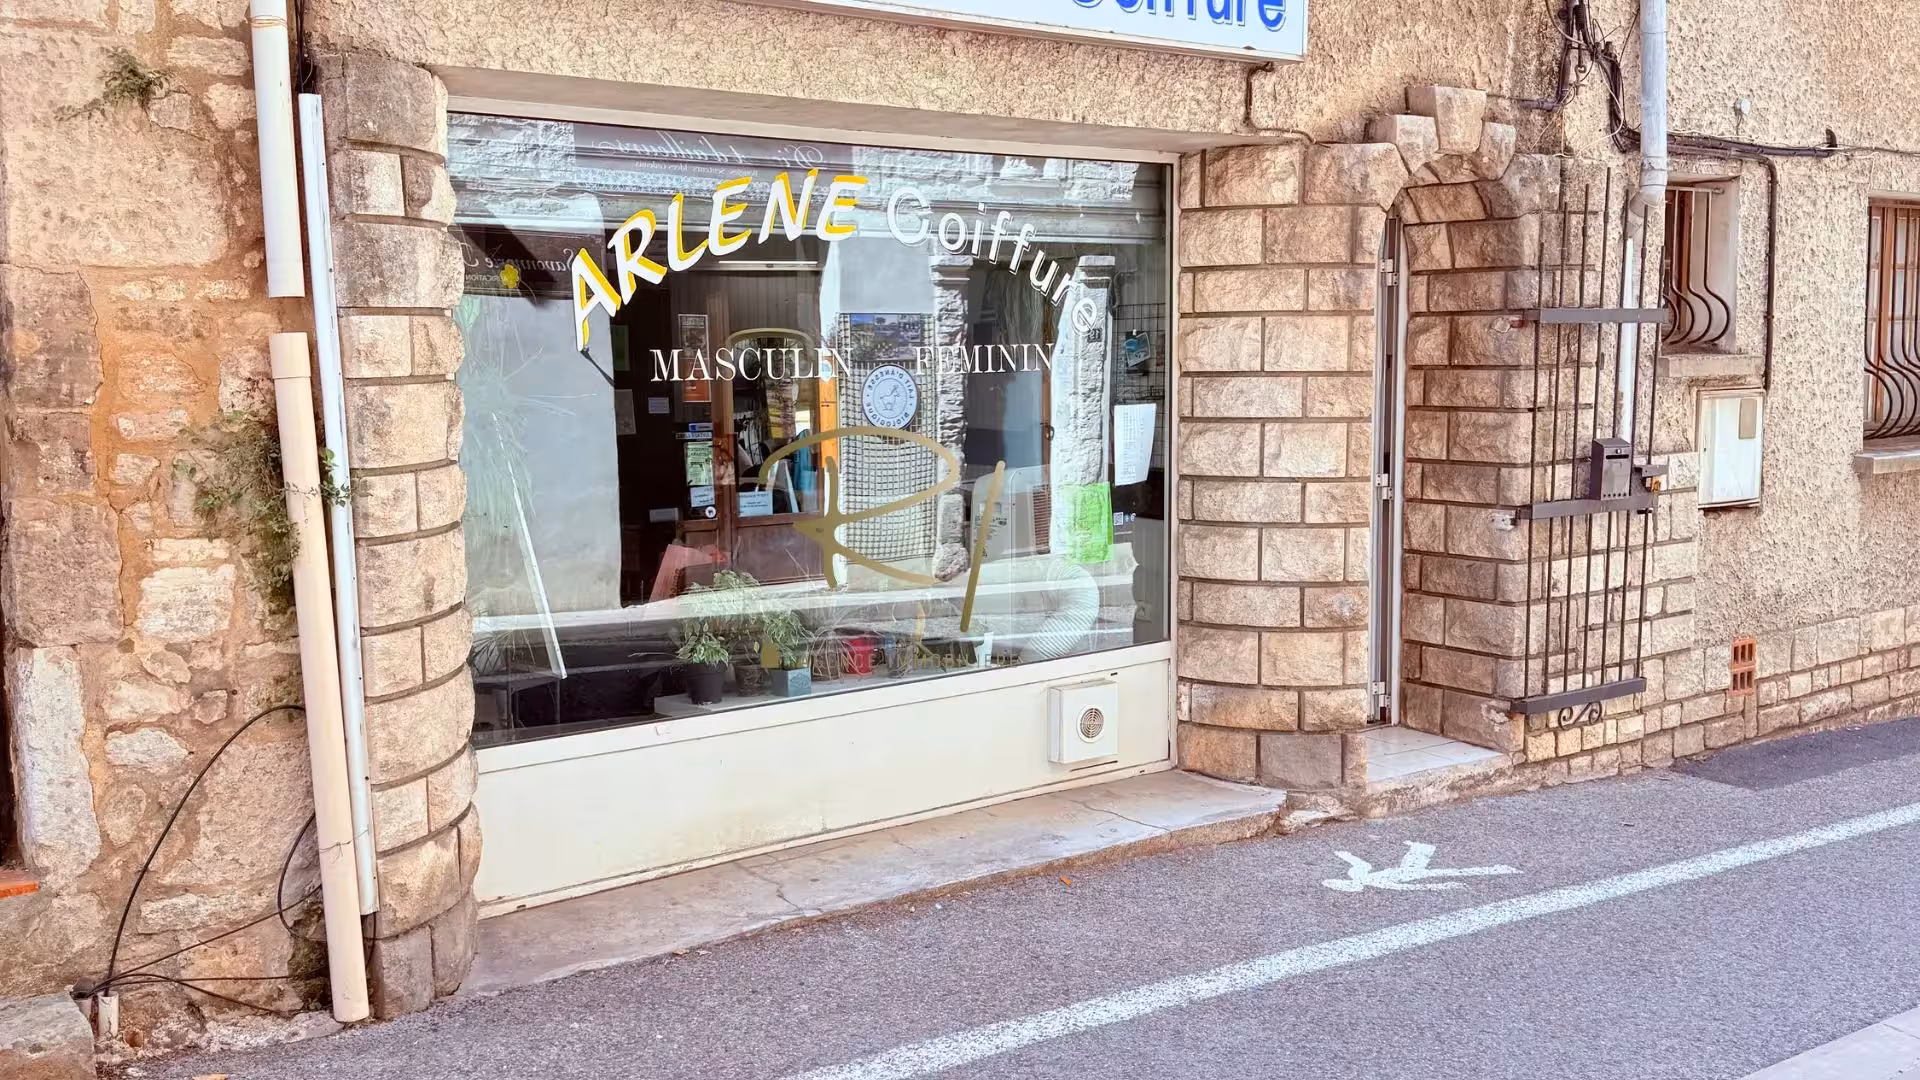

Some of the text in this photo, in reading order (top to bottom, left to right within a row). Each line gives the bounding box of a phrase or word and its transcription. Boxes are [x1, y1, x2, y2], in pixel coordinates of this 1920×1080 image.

[571, 168, 1098, 351] ARLENE Coiffure
[649, 342, 1054, 382] MASCULIN FEMININ
